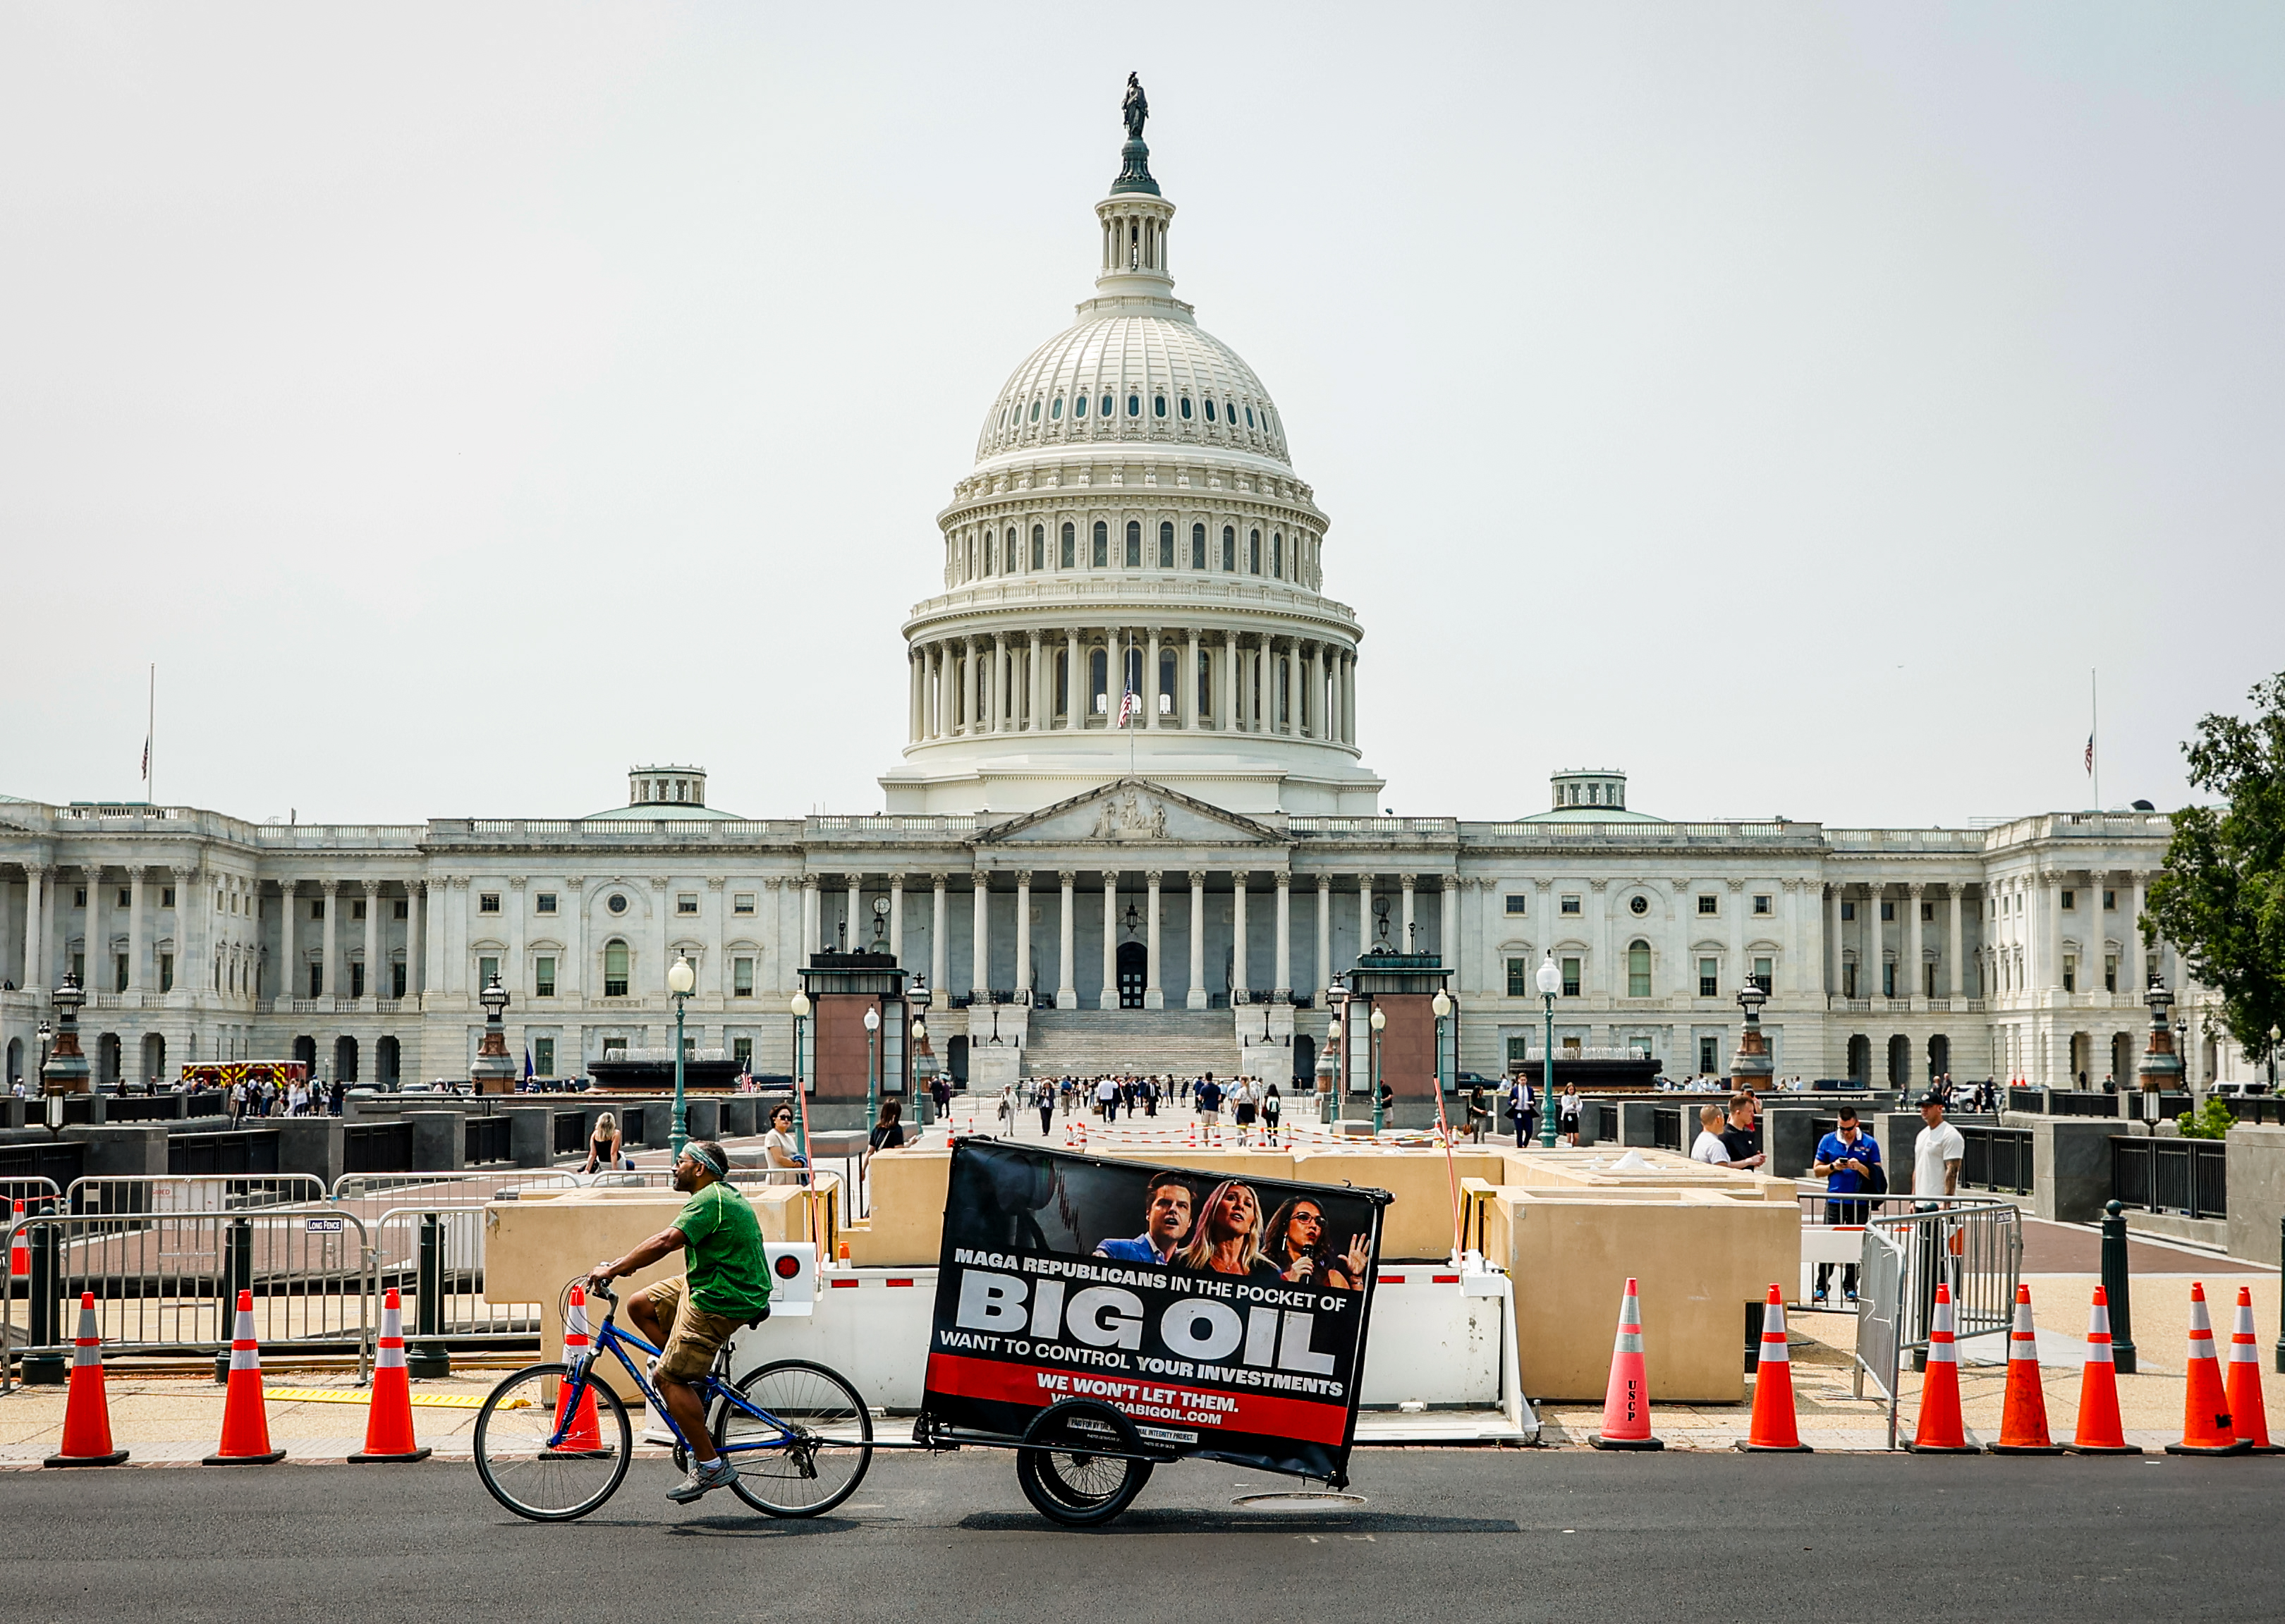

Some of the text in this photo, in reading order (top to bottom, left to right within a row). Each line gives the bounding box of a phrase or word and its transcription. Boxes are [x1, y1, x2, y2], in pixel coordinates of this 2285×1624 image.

[308, 1221, 340, 1230] LONG FENCE
[955, 1248, 1347, 1312] MAGA REPUBLICANS IN THE POCKET OF
[956, 1269, 1335, 1375] BIG OIL
[940, 1331, 1343, 1396] WANT TO CONTROL YOUR INVESTMENTS
[1037, 1372, 1068, 1391] WE
[1073, 1377, 1139, 1400] WON'T
[1142, 1386, 1176, 1405] LET
[1180, 1391, 1239, 1412] THEM.
[1102, 1400, 1221, 1424] GABIGOIL.COM
[1628, 1380, 1637, 1422] USCP
[1148, 1429, 1173, 1439] INTEGRITY
